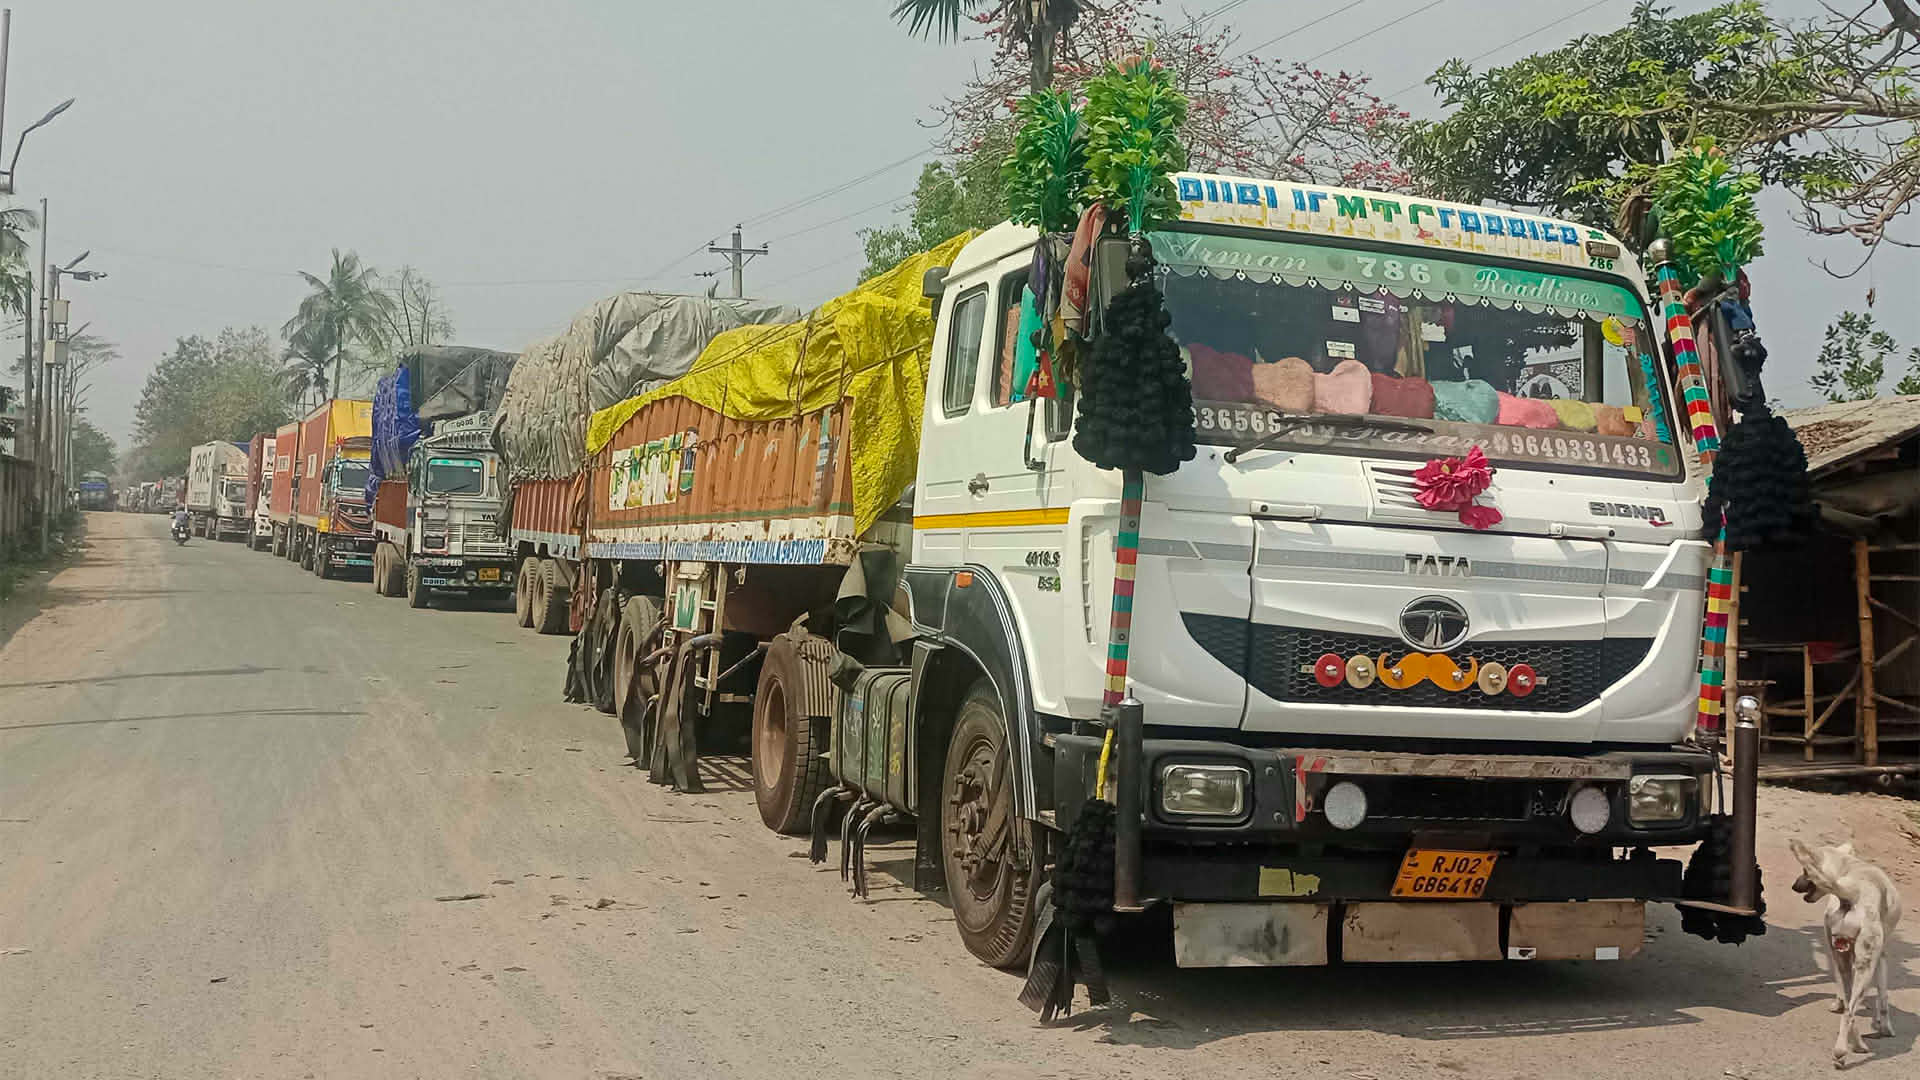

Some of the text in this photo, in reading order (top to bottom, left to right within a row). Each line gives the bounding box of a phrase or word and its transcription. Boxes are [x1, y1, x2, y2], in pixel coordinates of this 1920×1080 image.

[1589, 256, 1614, 271] 786
[1357, 256, 1432, 284] 786
[1473, 268, 1600, 307] Roadlines
[1511, 434, 1652, 468] 9649331433
[1588, 501, 1670, 525] SIGNA
[1405, 553, 1471, 578] TATA
[1431, 855, 1482, 874] RJ02
[1412, 875, 1485, 895] GB6418
